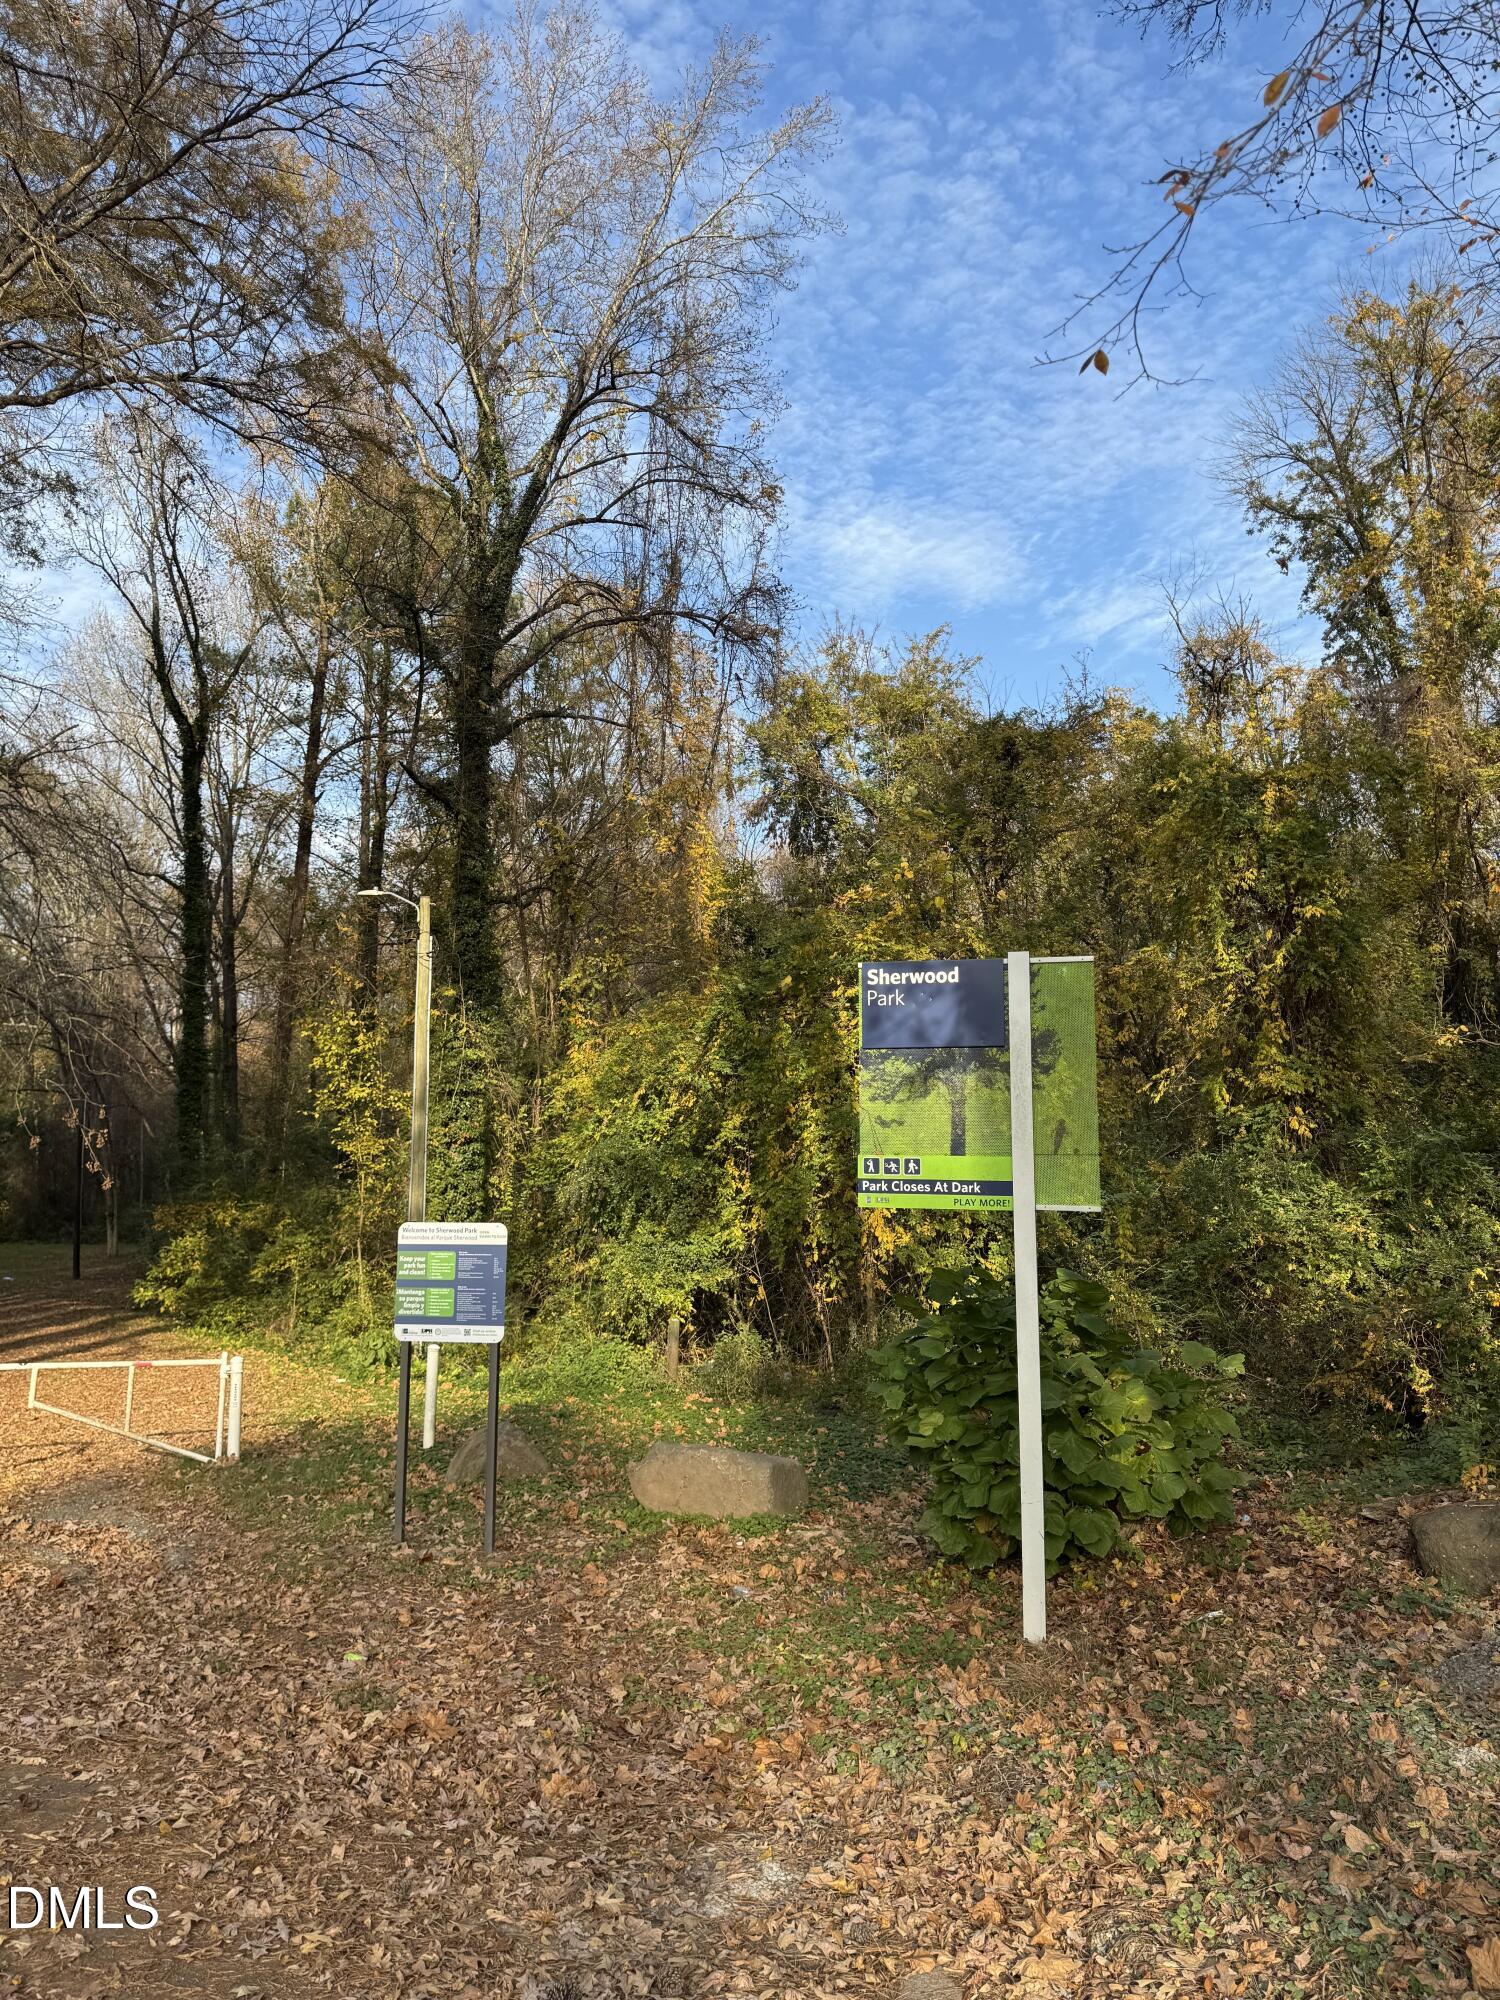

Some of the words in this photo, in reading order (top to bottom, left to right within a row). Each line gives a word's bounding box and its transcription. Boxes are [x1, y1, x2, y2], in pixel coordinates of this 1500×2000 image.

[867, 966, 959, 985] Sherwood
[867, 989, 905, 1006] Park
[862, 1180, 888, 1192] Park
[891, 1181, 931, 1192] Closes
[934, 1182, 948, 1193] At
[951, 1182, 981, 1193] Dark
[953, 1198, 976, 1207] PLAY
[979, 1199, 1010, 1207] MORE!
[400, 1255, 413, 1263] Keep
